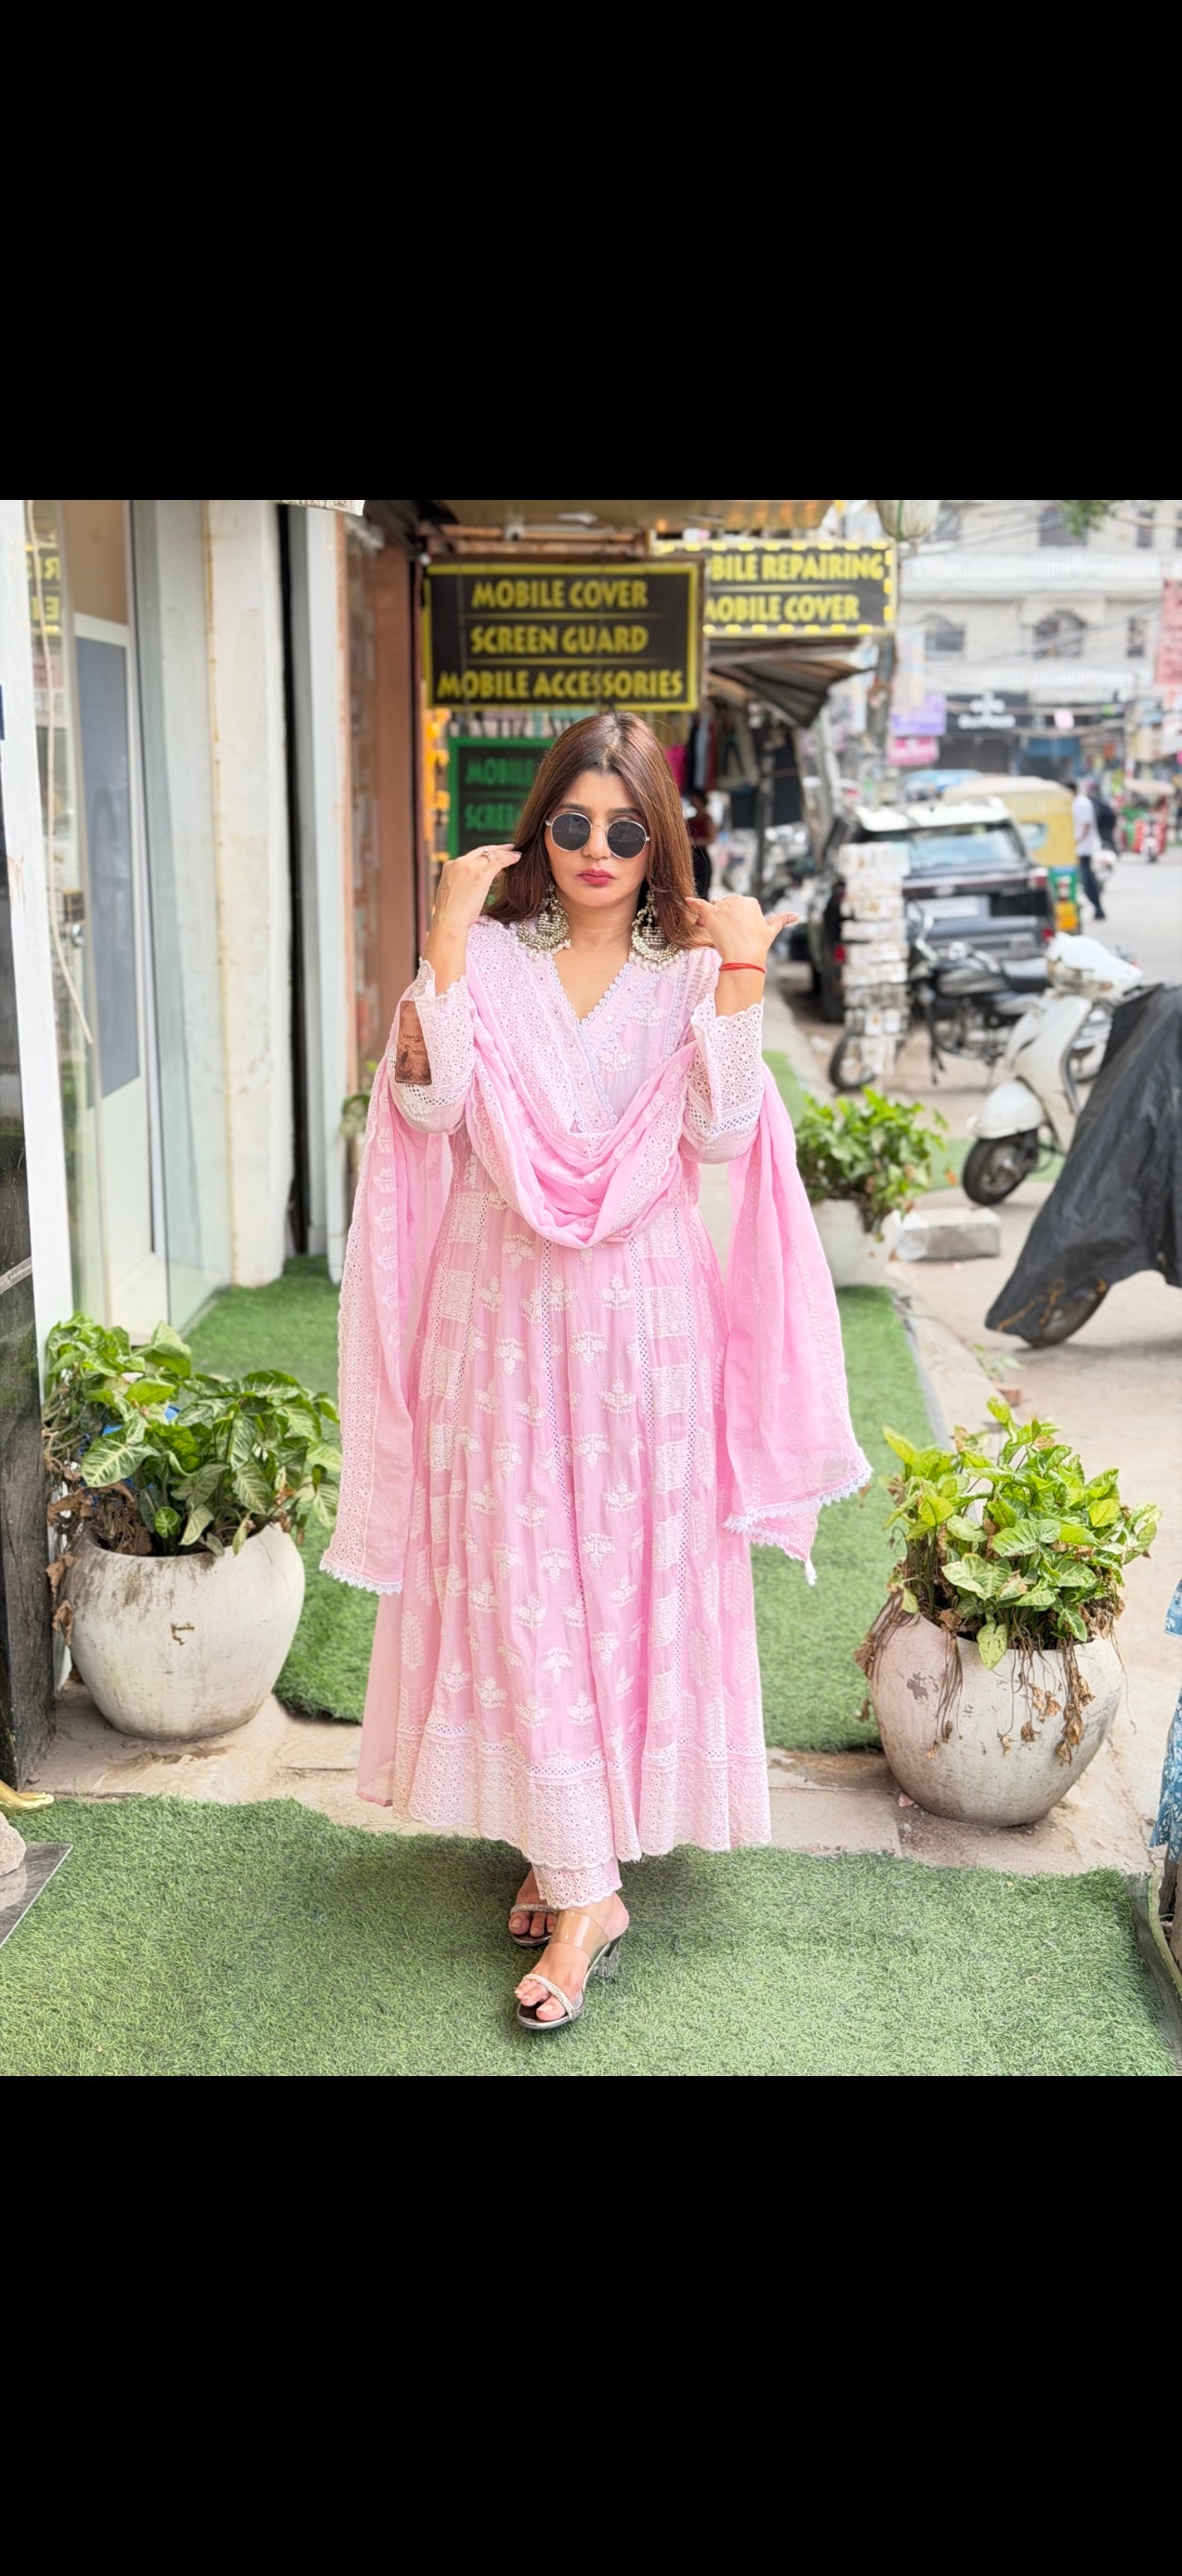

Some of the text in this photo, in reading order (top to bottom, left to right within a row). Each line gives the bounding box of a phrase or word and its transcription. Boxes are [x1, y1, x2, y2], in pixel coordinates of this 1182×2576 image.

[709, 552, 884, 582] BILE REPAIRING
[471, 579, 649, 608] MOBILE COVER
[782, 593, 860, 623] COVER
[470, 624, 649, 654] SCREEN GUARD
[436, 668, 684, 699] MOBILE ACCESSORIES
[464, 803, 522, 833] SCREE
